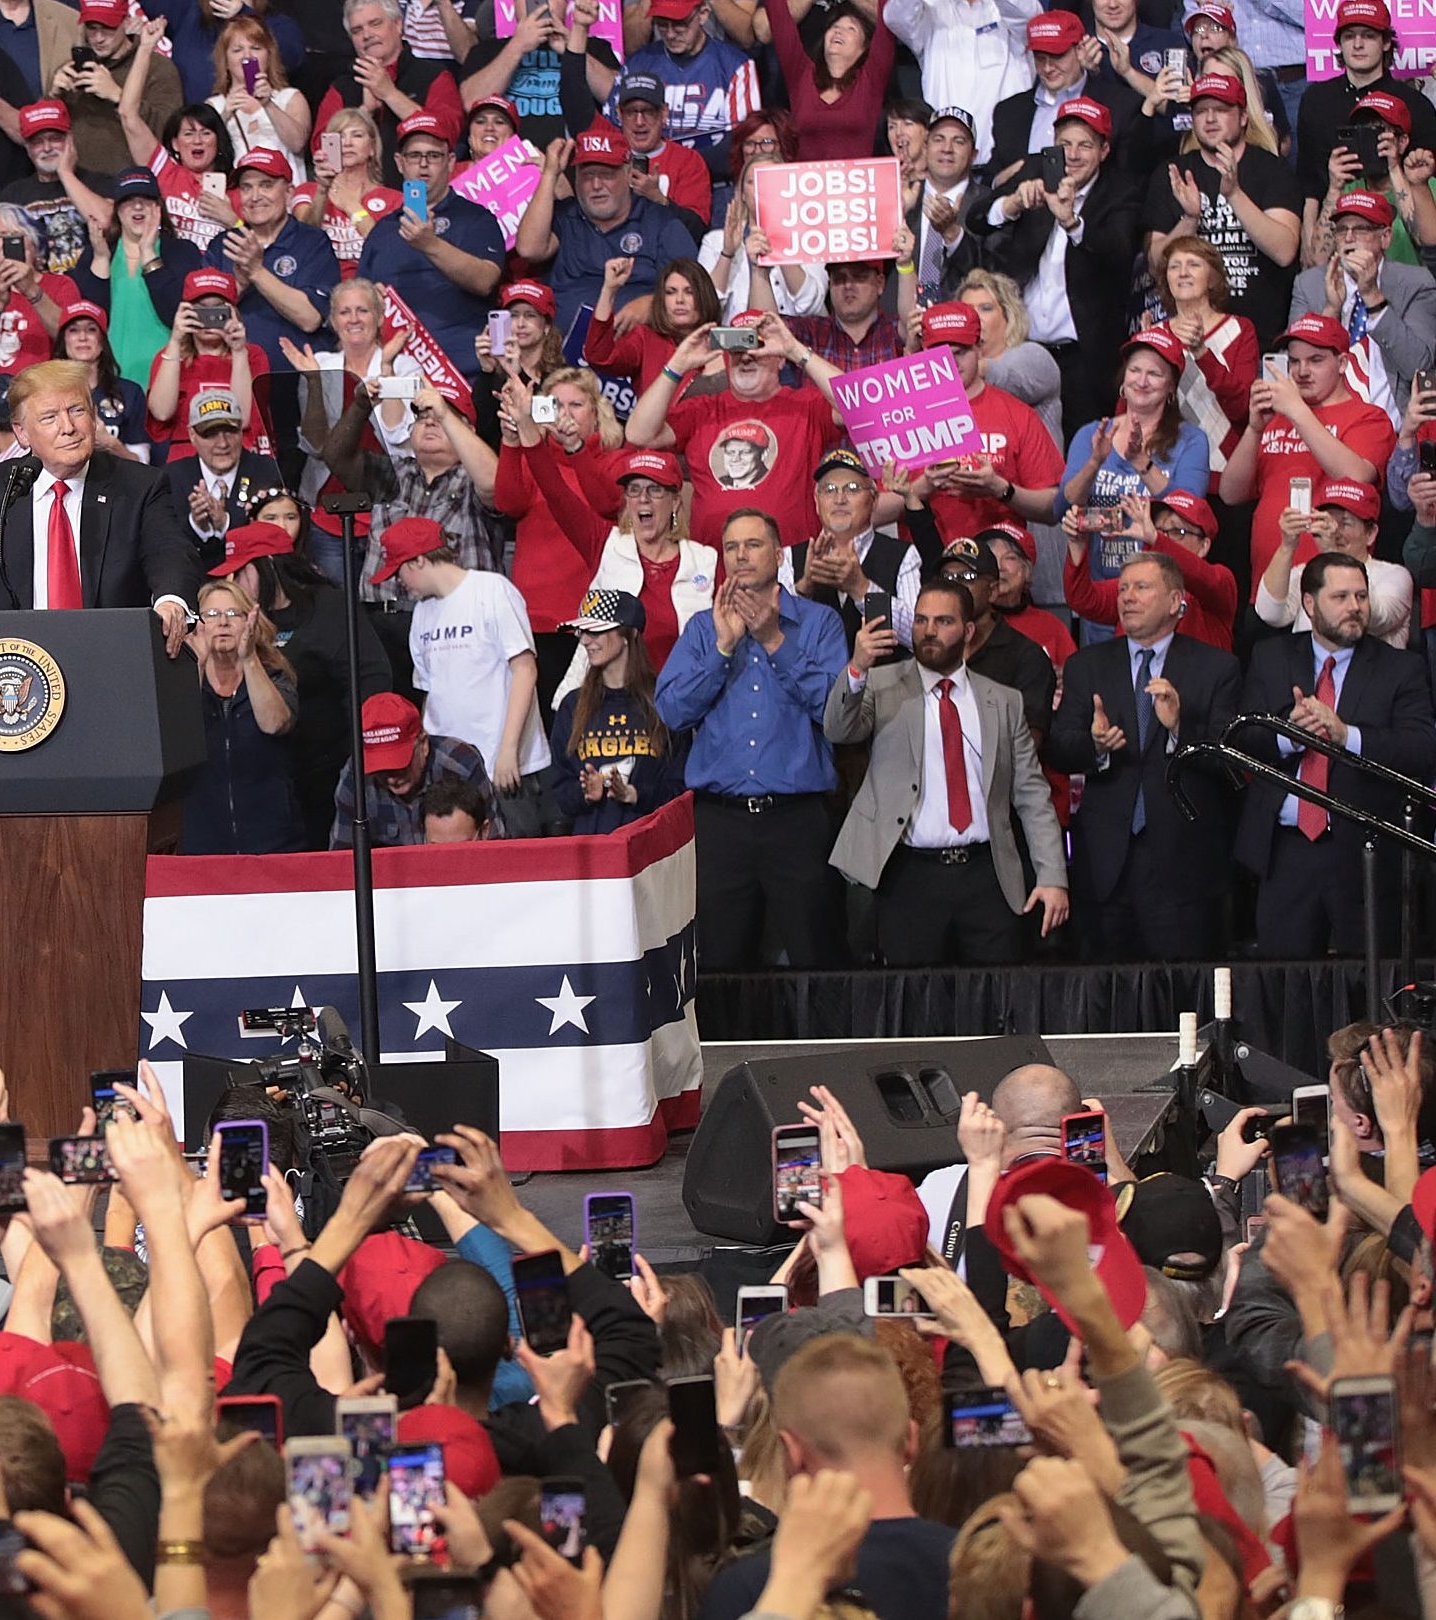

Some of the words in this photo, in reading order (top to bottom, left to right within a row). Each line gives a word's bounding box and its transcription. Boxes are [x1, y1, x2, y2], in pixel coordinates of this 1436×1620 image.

[1312, 0, 1436, 20] WEN
[1308, 47, 1436, 73] TMP
[582, 136, 613, 153] USA
[780, 168, 877, 199] JOBS!
[781, 197, 877, 228] JOBS!
[782, 226, 878, 257] JOBS!
[836, 356, 955, 410] WOMEN
[200, 401, 231, 415] ARMY
[881, 406, 916, 428] FOR
[855, 415, 975, 468] TRUMP
[1095, 483, 1119, 496] THE
[1097, 470, 1141, 486] STAND
[38, 655, 62, 701] UNITED
[20, 710, 57, 746] STATES
[944, 1220, 961, 1258] Canon
